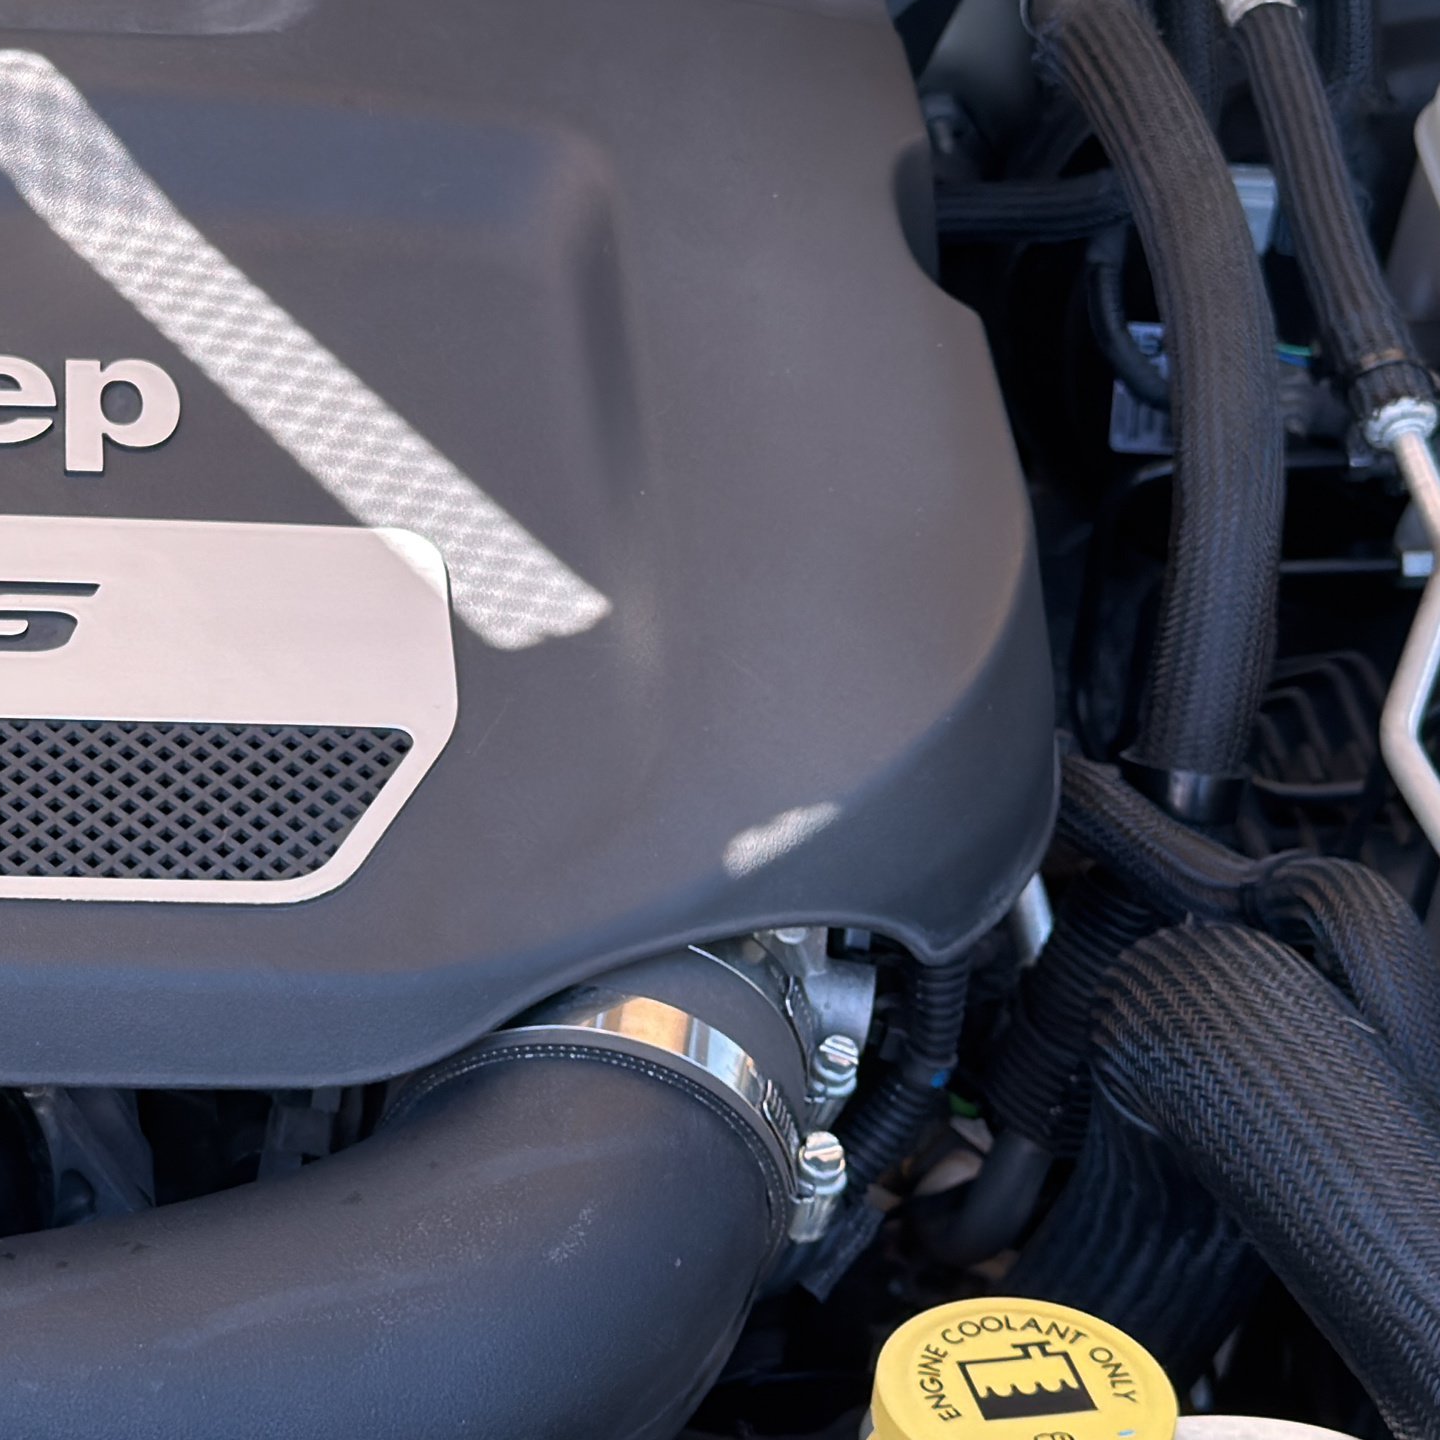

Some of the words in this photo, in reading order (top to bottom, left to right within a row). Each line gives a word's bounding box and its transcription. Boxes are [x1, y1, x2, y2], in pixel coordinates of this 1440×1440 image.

[917, 1343, 962, 1422] ENGINE
[941, 1314, 1089, 1345] COOLANT
[1088, 1346, 1139, 1404] ONLY
